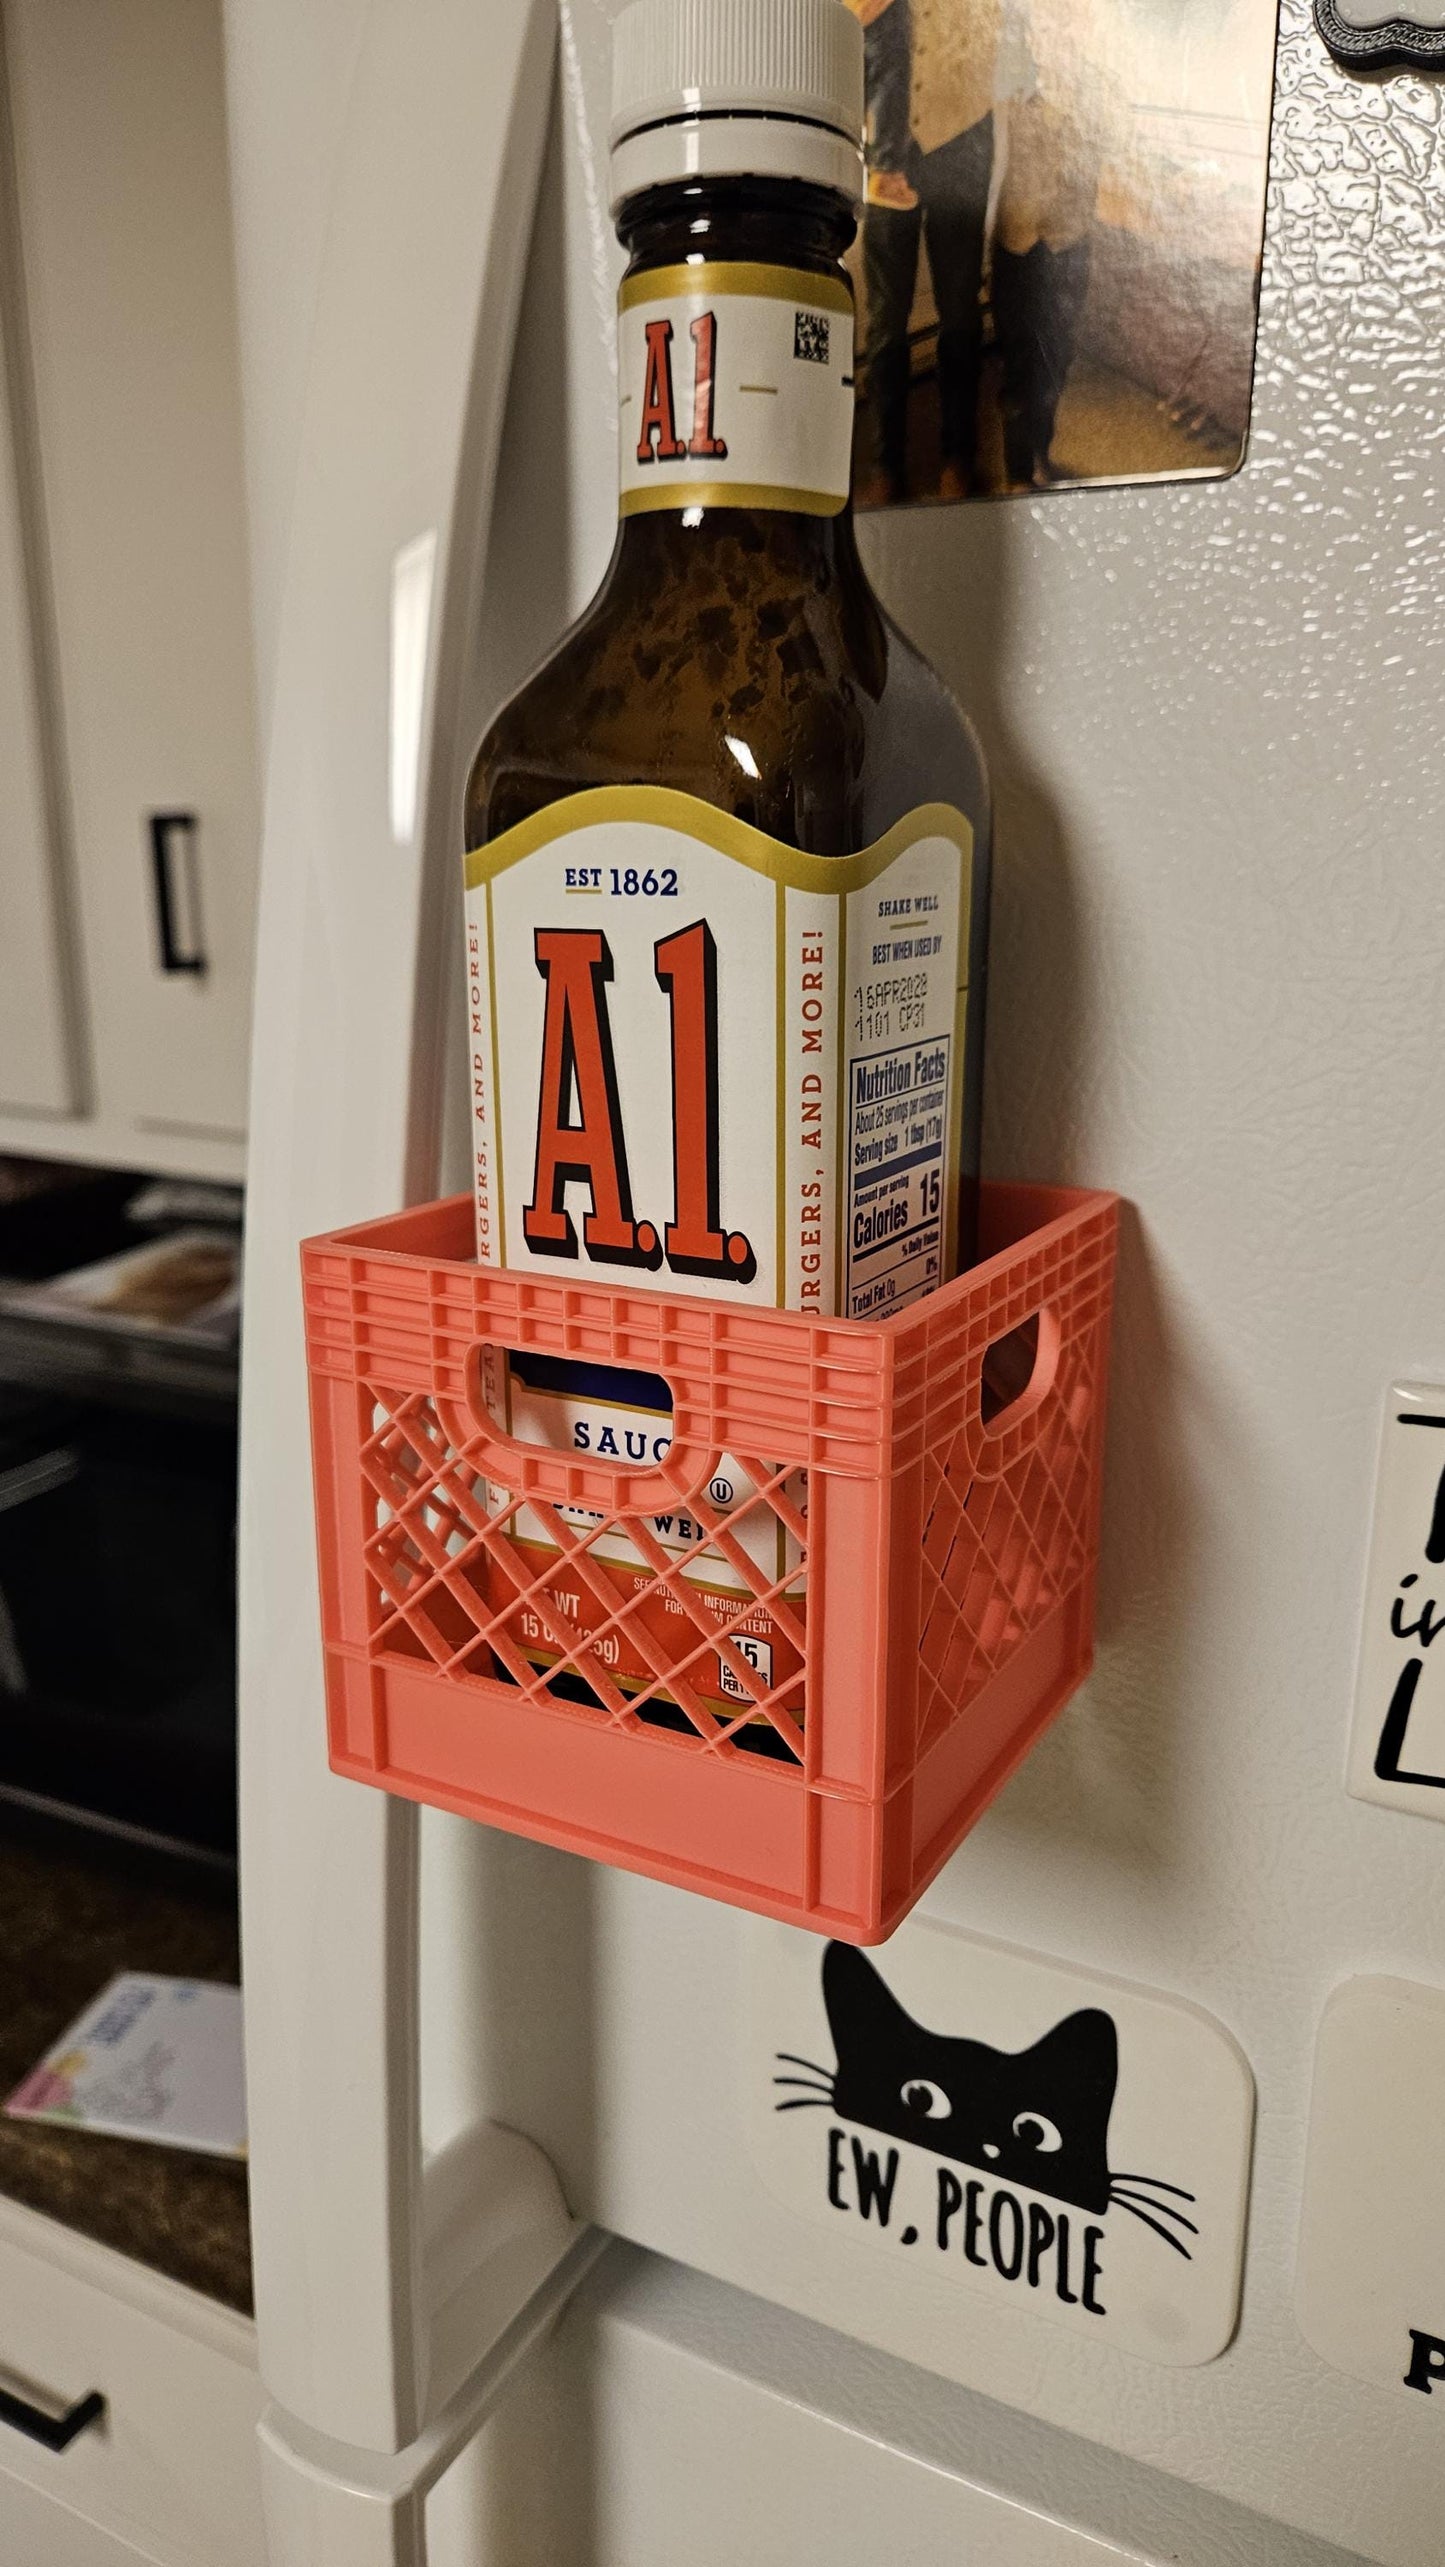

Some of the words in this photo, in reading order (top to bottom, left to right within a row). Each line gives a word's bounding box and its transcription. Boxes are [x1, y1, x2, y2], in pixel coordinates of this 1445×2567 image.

[565, 868, 602, 887] EST
[609, 868, 678, 896] 1862
[878, 899, 911, 917] SHAKE
[915, 895, 939, 912] WELL
[872, 943, 891, 965] BEST
[892, 940, 913, 961] WHEN
[914, 937, 931, 958] USED
[933, 935, 942, 955] BY
[468, 923, 482, 1035] MORE!
[802, 931, 823, 1053] MORE!
[473, 1053, 486, 1122] AND
[857, 1058, 911, 1104] Nutrition
[914, 1047, 945, 1086] Facts
[523, 918, 757, 1285] A.1.
[801, 1074, 822, 1149] AND
[855, 1108, 875, 1136] About
[876, 1105, 884, 1129] 25
[884, 1100, 908, 1125] servings
[909, 1098, 919, 1121] per
[855, 1138, 883, 1166] Serving
[884, 1132, 898, 1155] size
[904, 1126, 909, 1147] 1
[910, 1123, 924, 1145] tbsp
[926, 1114, 942, 1143] (17g)
[854, 1186, 877, 1208] Amount
[878, 1184, 888, 1200] per
[889, 1175, 909, 1193] serving
[854, 1198, 908, 1249] Calories
[920, 1168, 940, 1217] 15
[852, 1288, 873, 1314] Total
[873, 1281, 886, 1304] Fat
[886, 1278, 896, 1297] 0g
[574, 1421, 672, 1463] SAUC
[521, 1612, 539, 1638] 15
[554, 1590, 580, 1618] WT
[724, 1678, 739, 1693] PER
[828, 2127, 919, 2246] EW,
[936, 2167, 1107, 2316] PEOPLE
